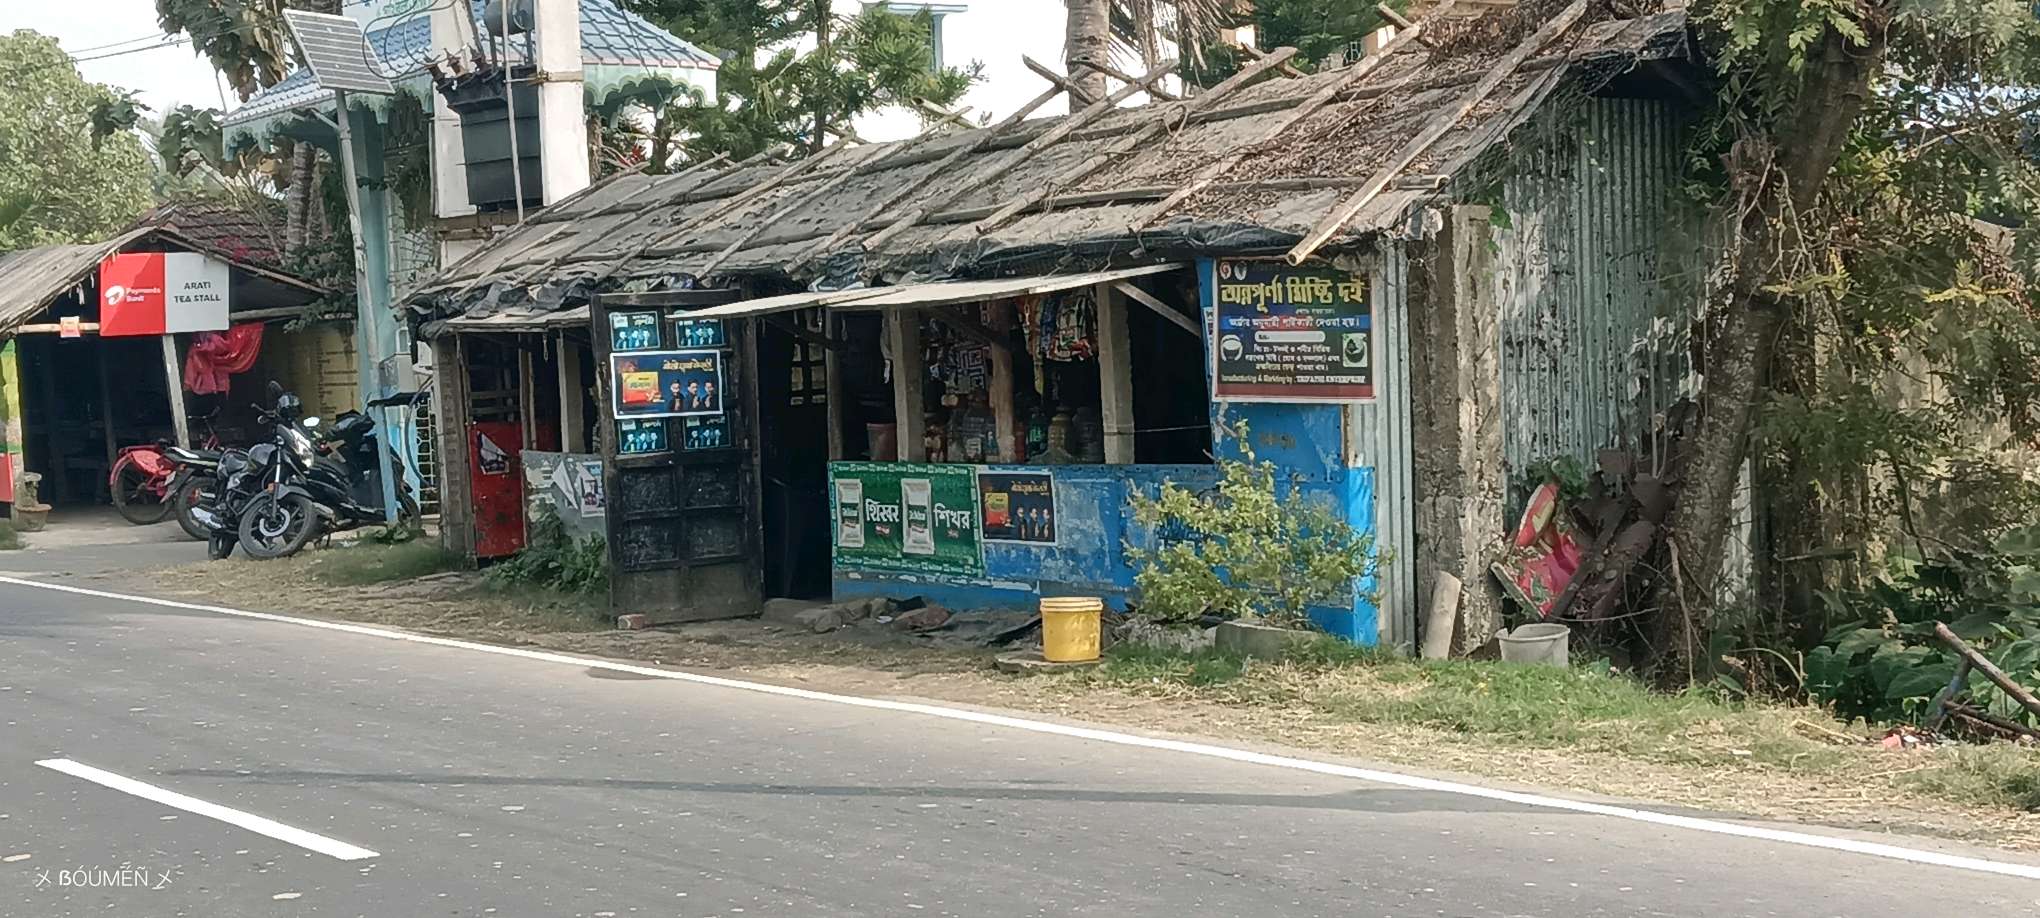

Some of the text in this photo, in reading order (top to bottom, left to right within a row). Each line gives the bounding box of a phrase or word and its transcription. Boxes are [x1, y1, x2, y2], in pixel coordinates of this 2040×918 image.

[184, 282, 211, 290] ARATI
[1285, 276, 1334, 304] মিষ্টি
[173, 294, 221, 303] TEA STALL
[933, 503, 971, 529] শিখর
